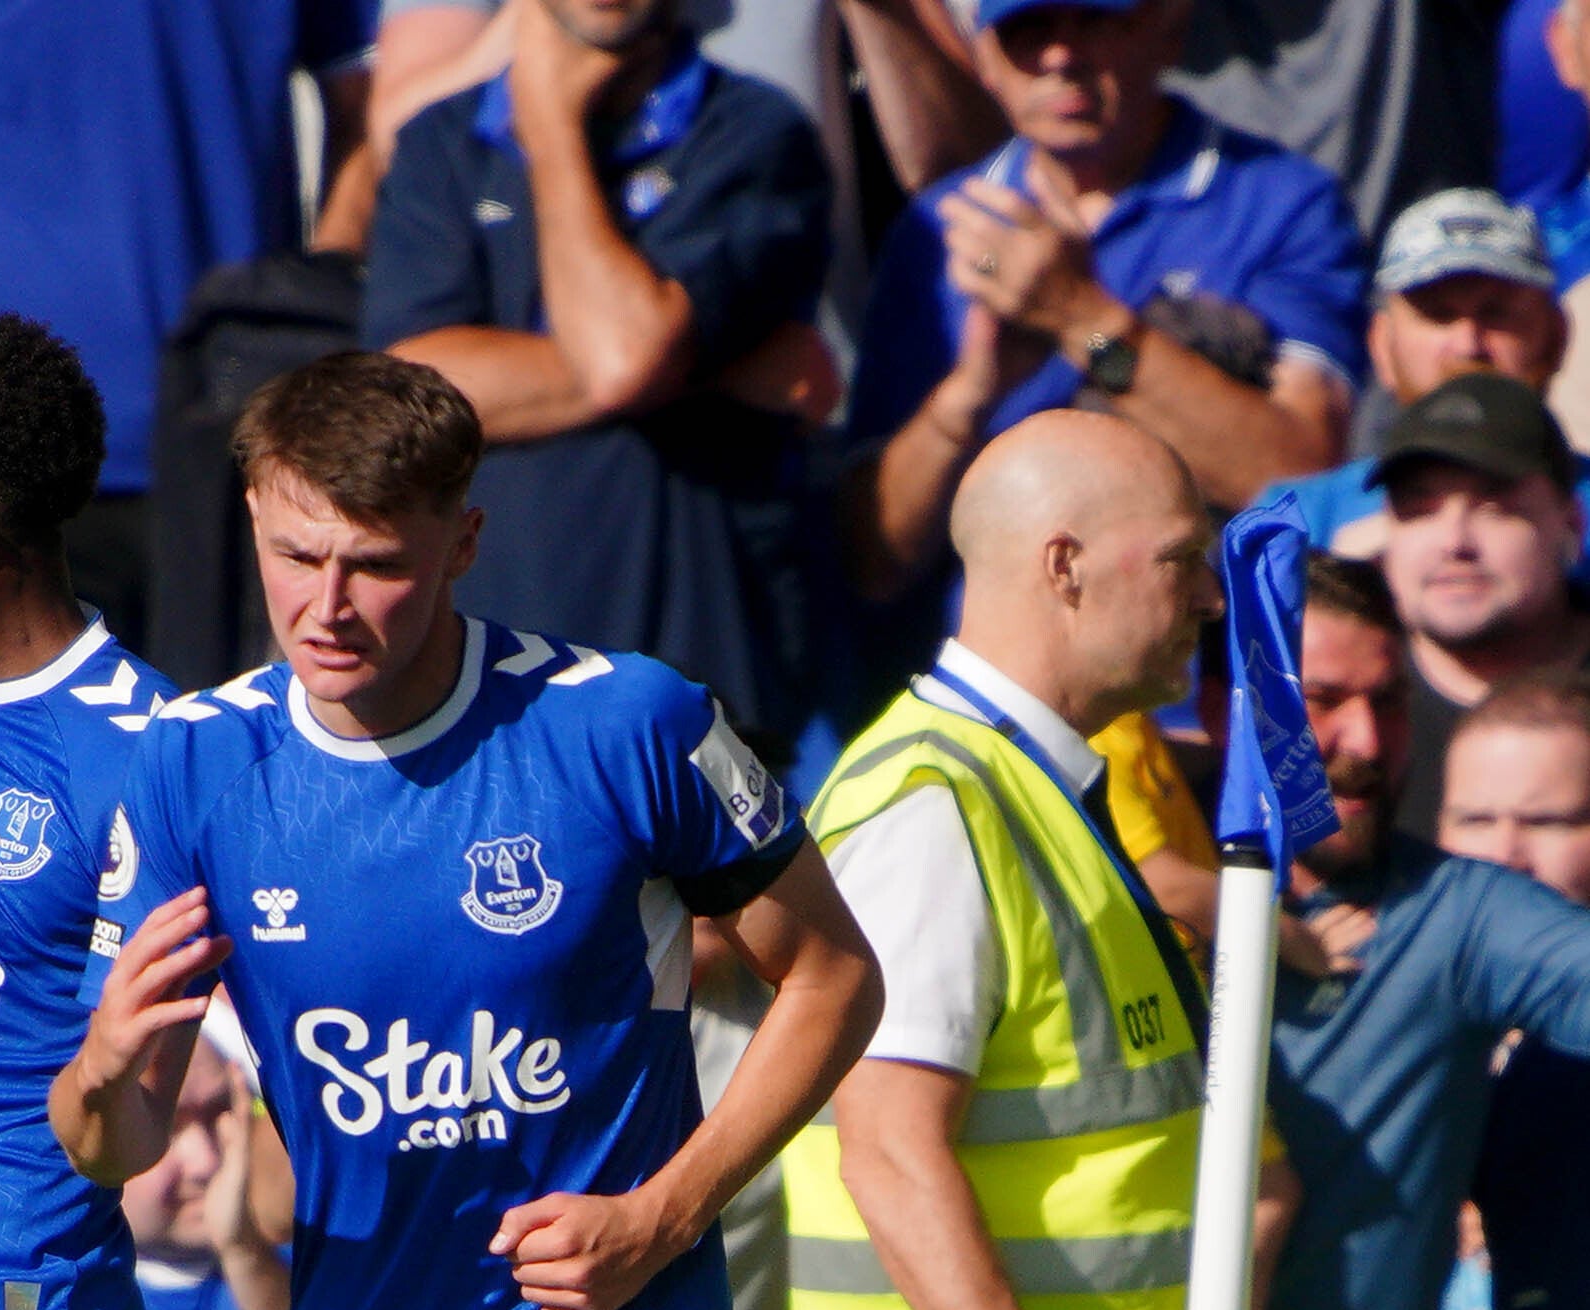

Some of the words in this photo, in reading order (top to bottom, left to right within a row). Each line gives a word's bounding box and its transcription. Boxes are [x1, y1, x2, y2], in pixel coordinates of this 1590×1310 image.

[485, 888, 537, 905] Everton
[1123, 992, 1165, 1050] 037
[295, 1008, 571, 1136] Stake
[398, 1109, 507, 1151] .com
